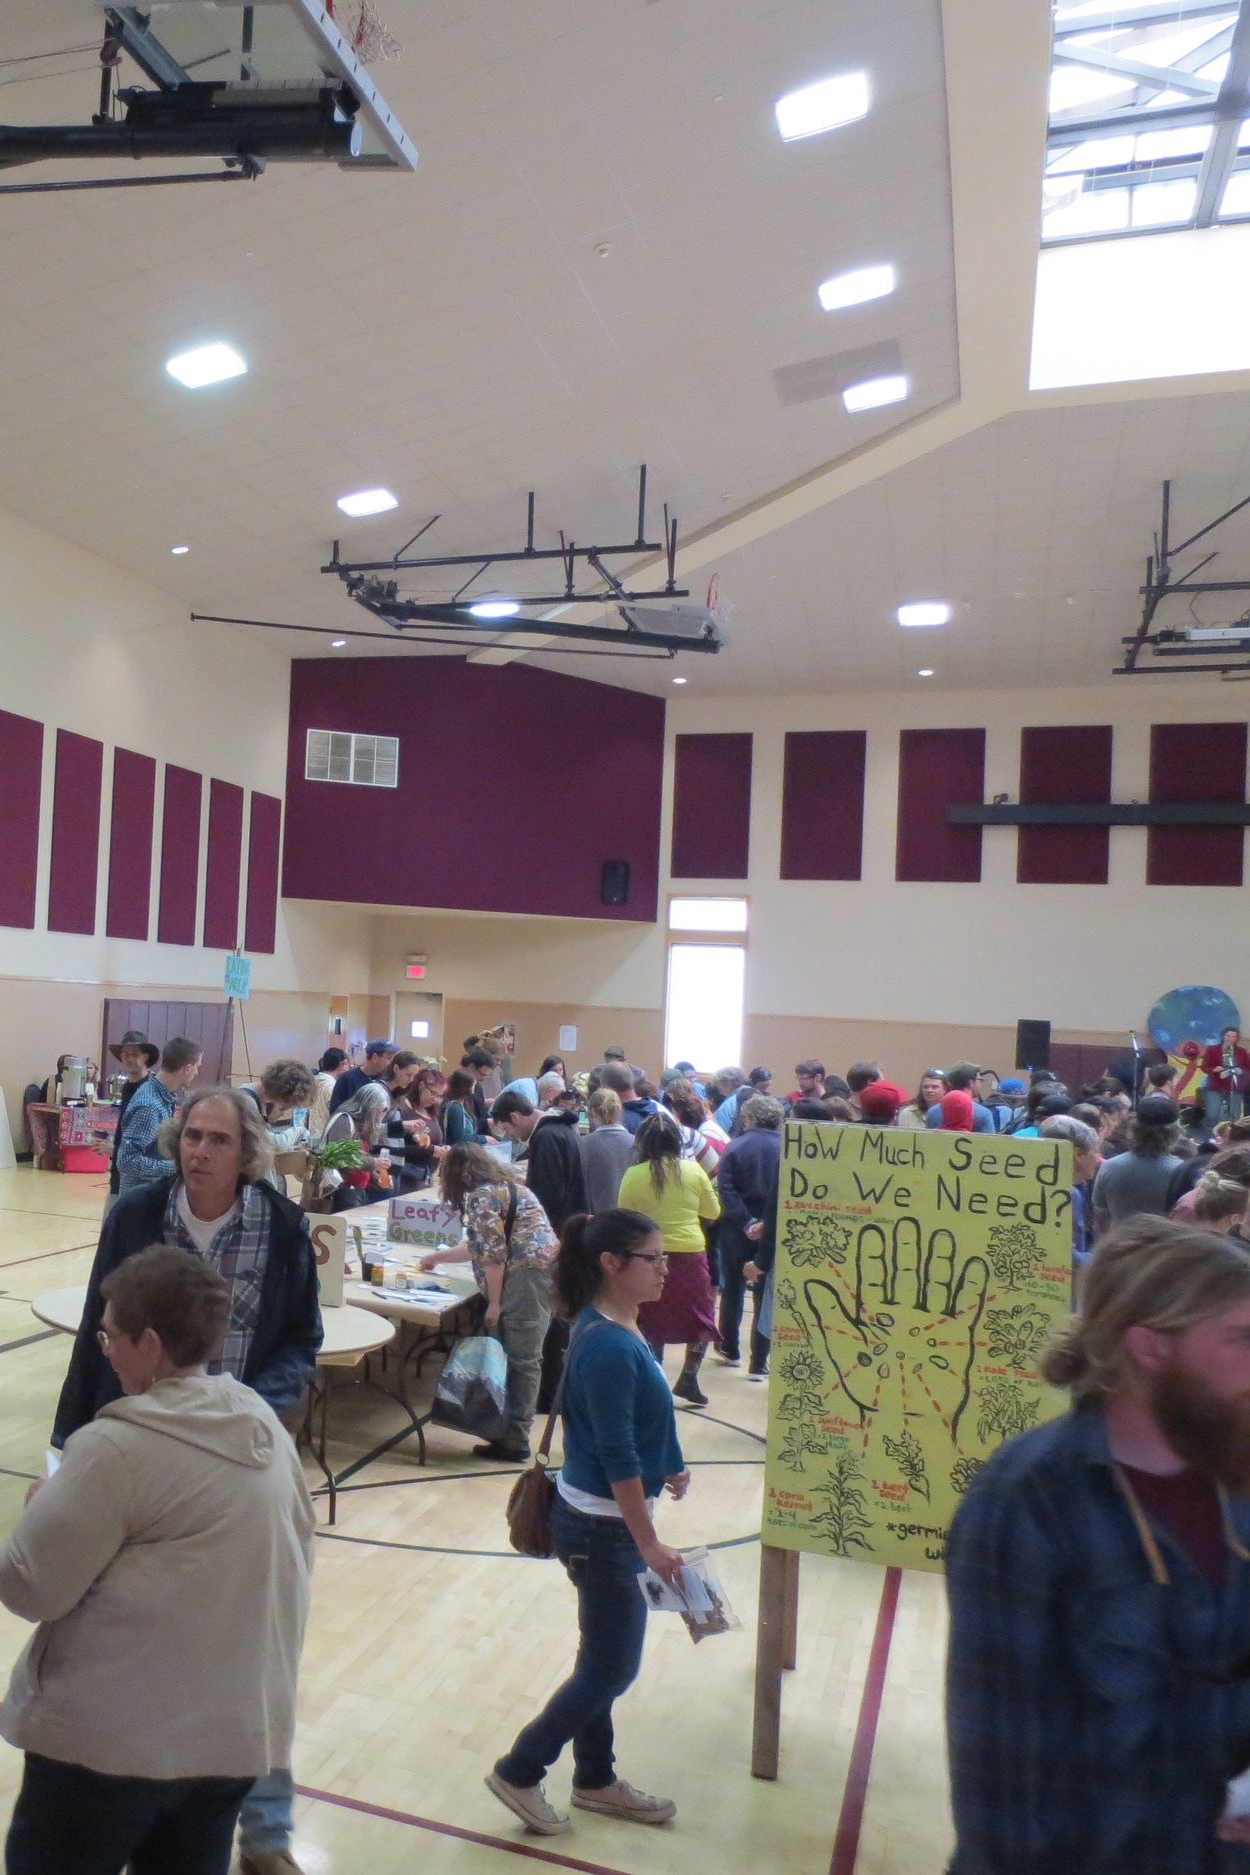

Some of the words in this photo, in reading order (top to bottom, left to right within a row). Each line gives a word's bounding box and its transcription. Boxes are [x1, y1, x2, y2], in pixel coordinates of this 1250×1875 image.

[860, 1129, 925, 1170] Much
[949, 1137, 1061, 1187] Seed
[391, 1200, 461, 1228] Leafy
[790, 1167, 829, 1200] Do
[852, 1171, 912, 1208] We
[937, 1174, 1072, 1228] Need?
[389, 1221, 459, 1248] Greens
